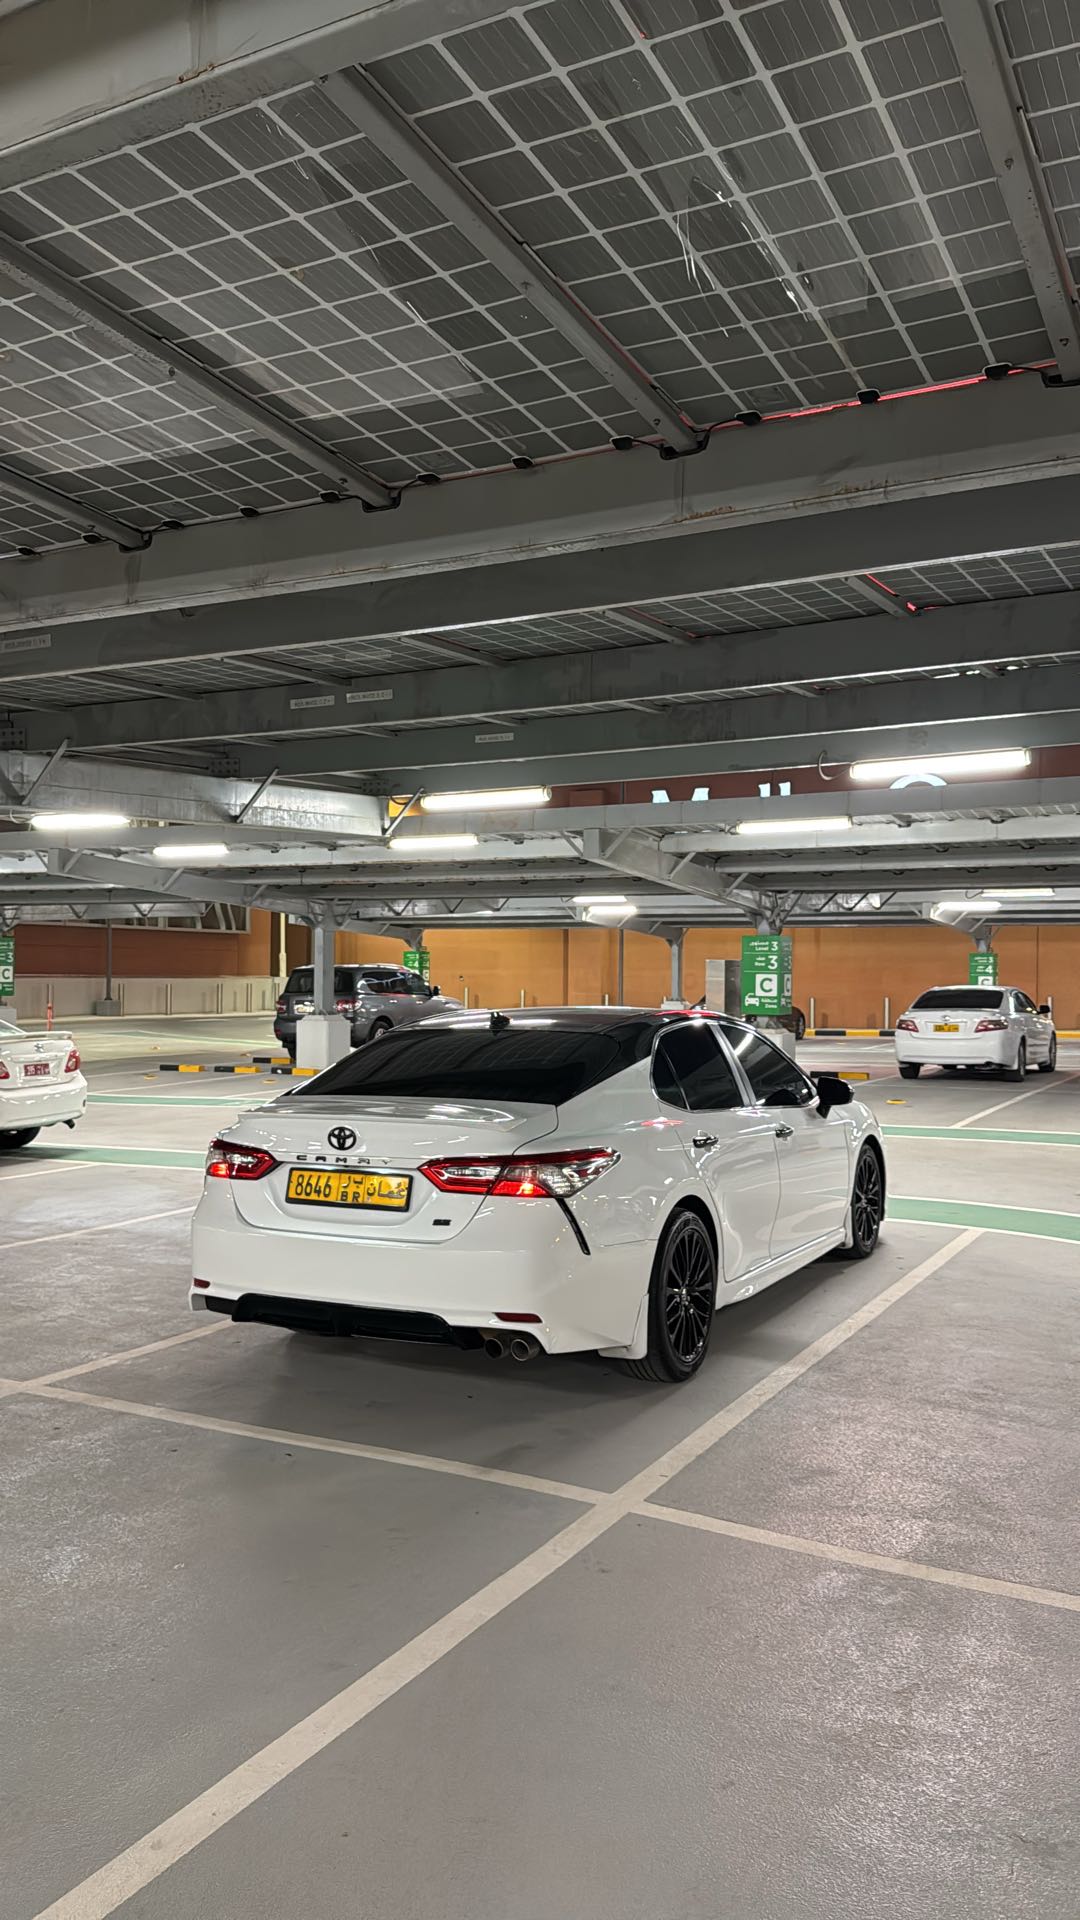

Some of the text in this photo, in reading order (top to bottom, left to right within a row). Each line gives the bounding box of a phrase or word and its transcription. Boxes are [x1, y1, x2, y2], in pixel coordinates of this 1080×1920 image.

[771, 941, 778, 951] 3
[767, 955, 778, 970] 3
[2, 968, 10, 980] C
[760, 977, 773, 993] C
[295, 1174, 332, 1198] 8646
